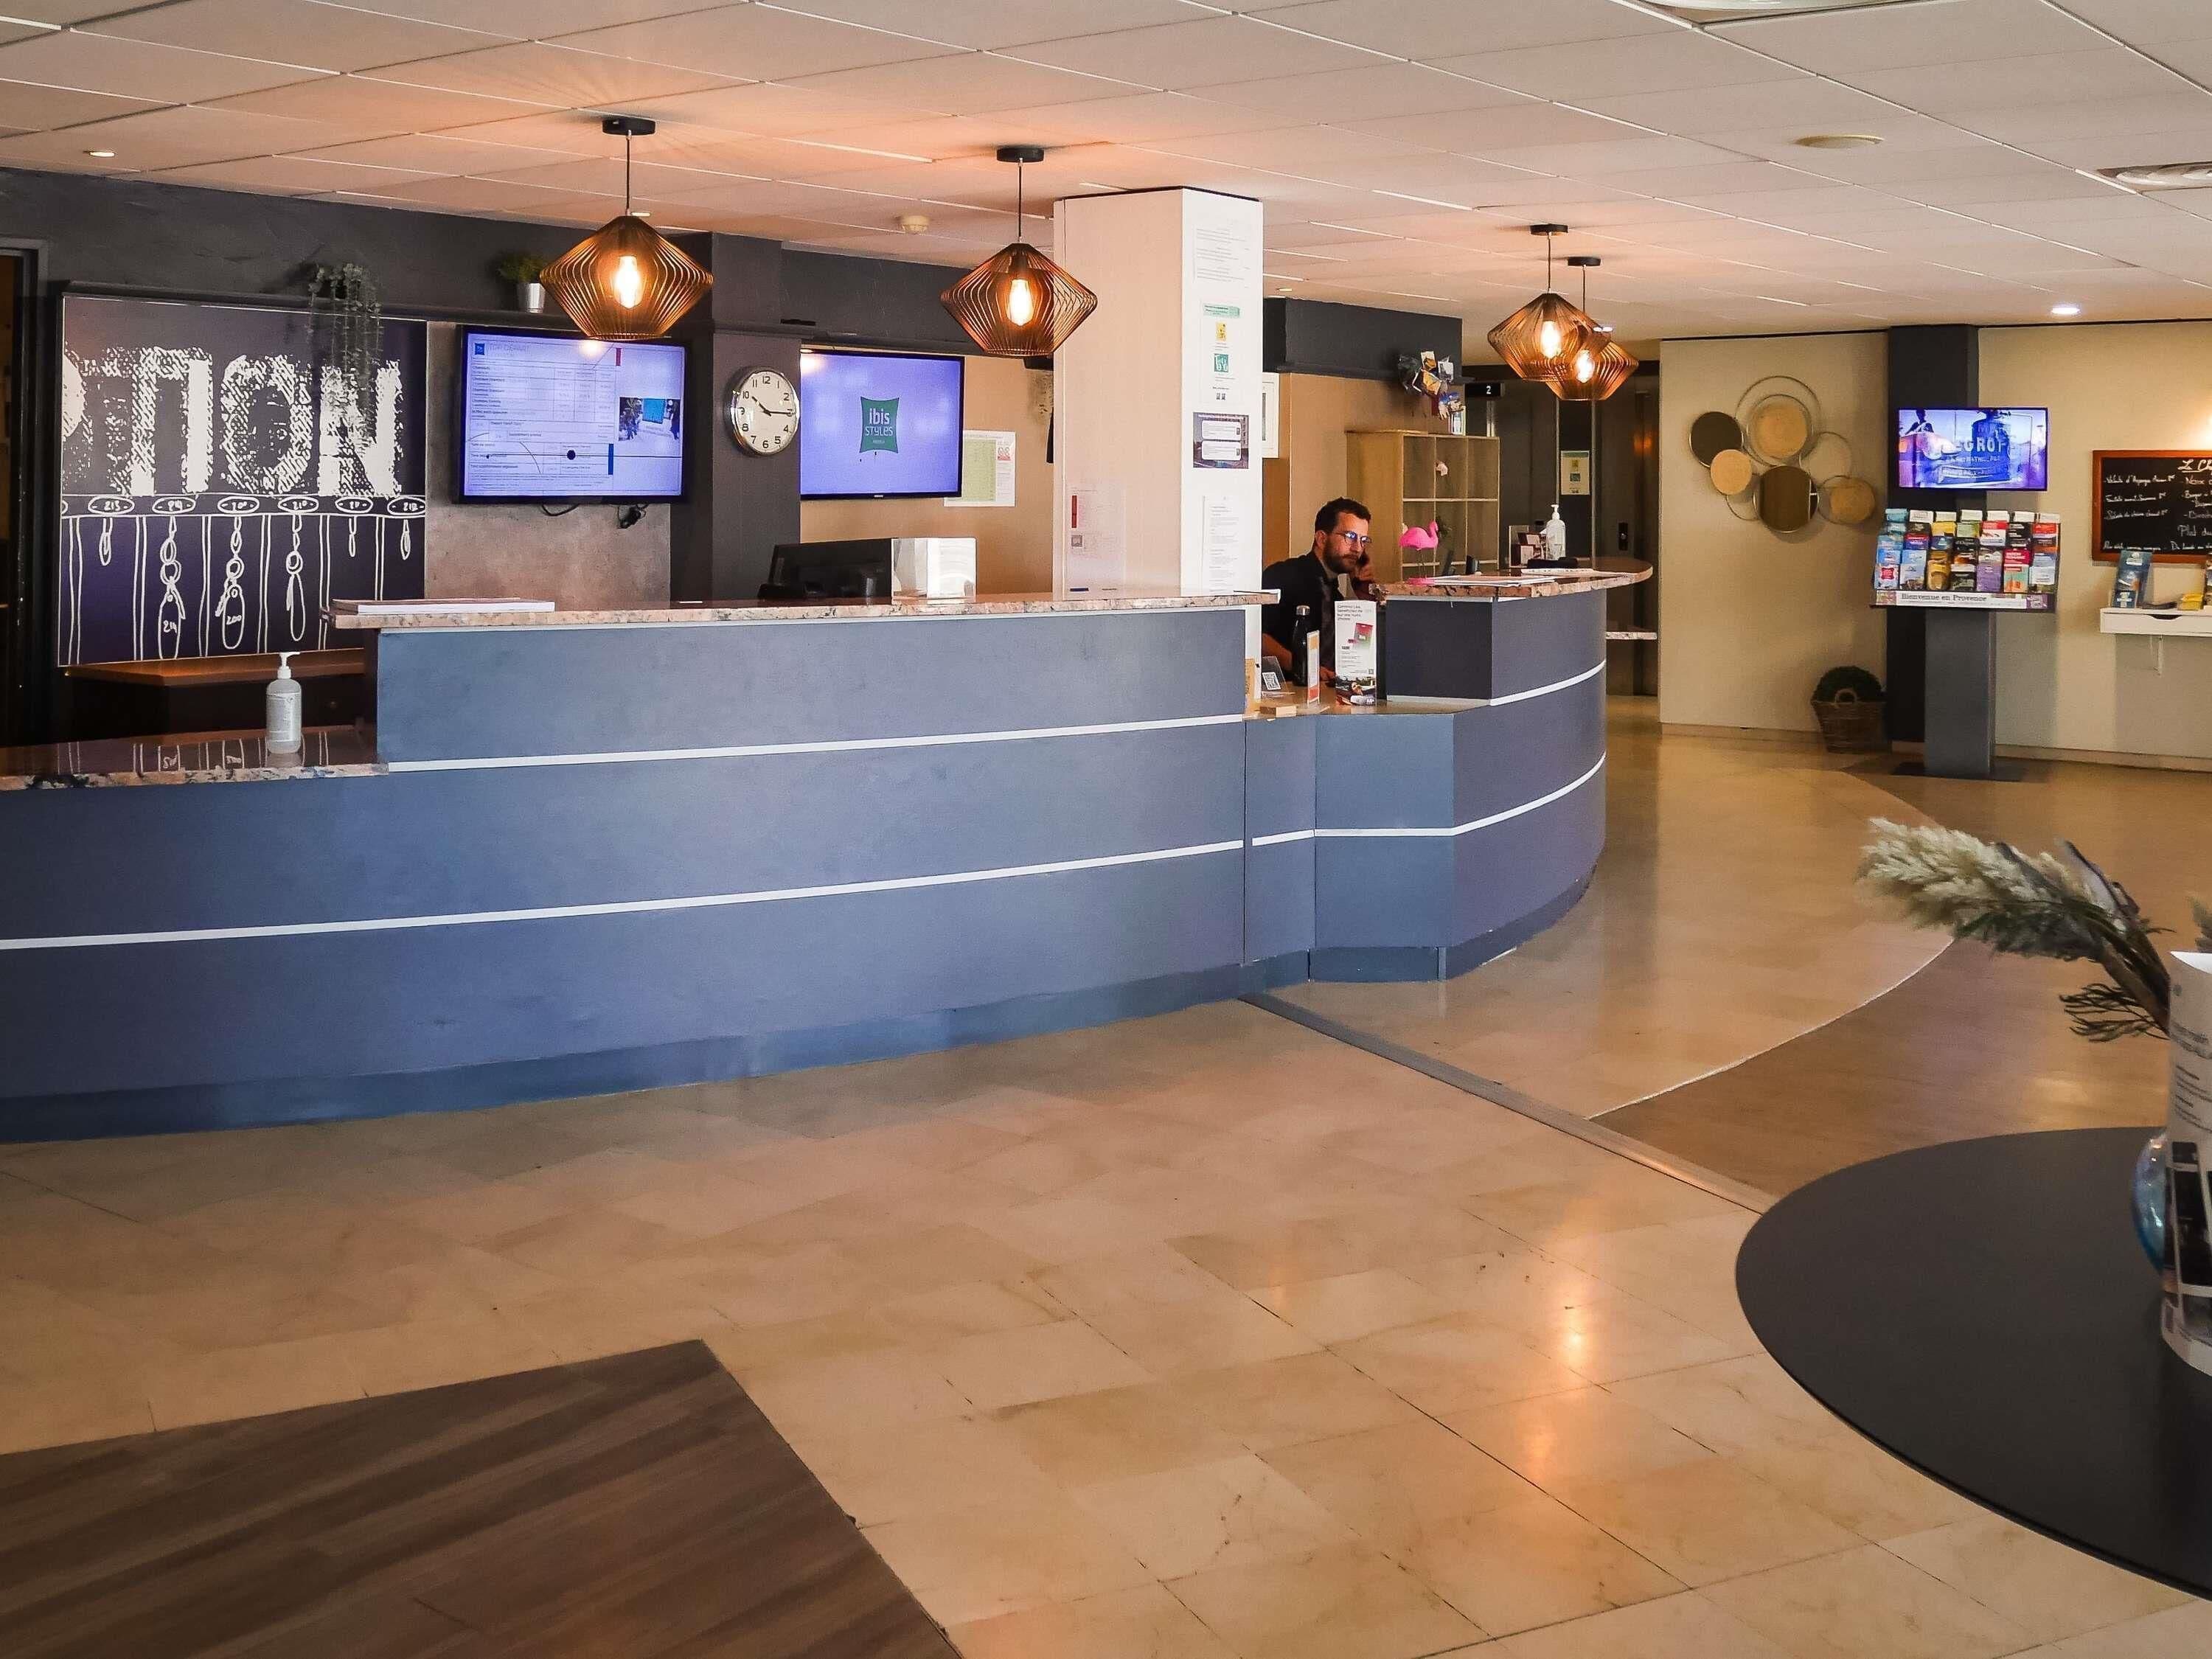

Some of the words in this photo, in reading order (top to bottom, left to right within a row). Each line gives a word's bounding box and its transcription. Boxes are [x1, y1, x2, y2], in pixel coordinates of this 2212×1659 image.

[752, 379, 758, 388] 11
[762, 376, 771, 384] 12
[1486, 385, 1492, 394] 2
[742, 391, 750, 399] 10
[783, 392, 790, 401] 2
[869, 408, 890, 425] ibis
[742, 423, 749, 432] 8
[783, 425, 790, 433] 4
[751, 435, 757, 444] 7
[774, 436, 781, 444] 5
[762, 440, 769, 448] 6
[1900, 593, 1941, 601] Bienvenue
